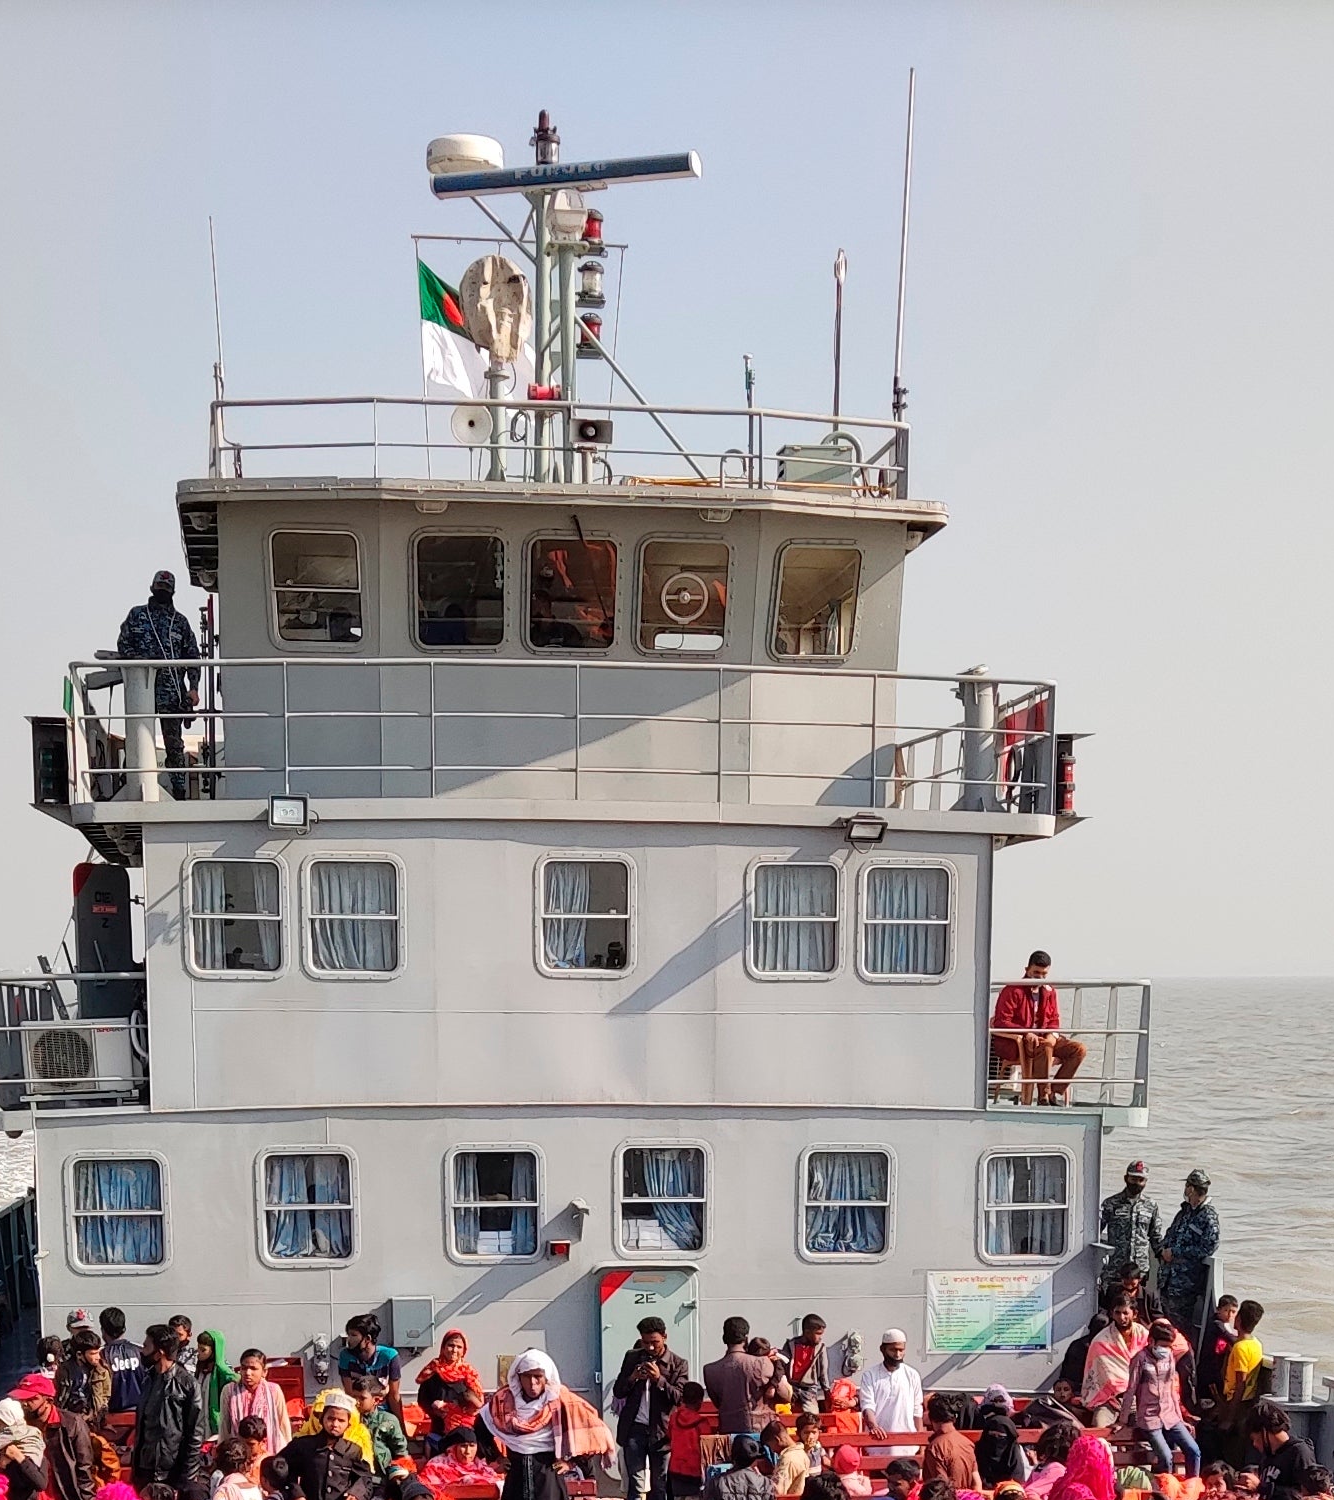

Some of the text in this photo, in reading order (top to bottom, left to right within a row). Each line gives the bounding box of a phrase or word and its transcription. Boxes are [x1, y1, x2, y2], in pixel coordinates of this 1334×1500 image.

[514, 161, 606, 180] FURUNO
[634, 1292, 657, 1305] 2E
[111, 1357, 140, 1372] Jeep
